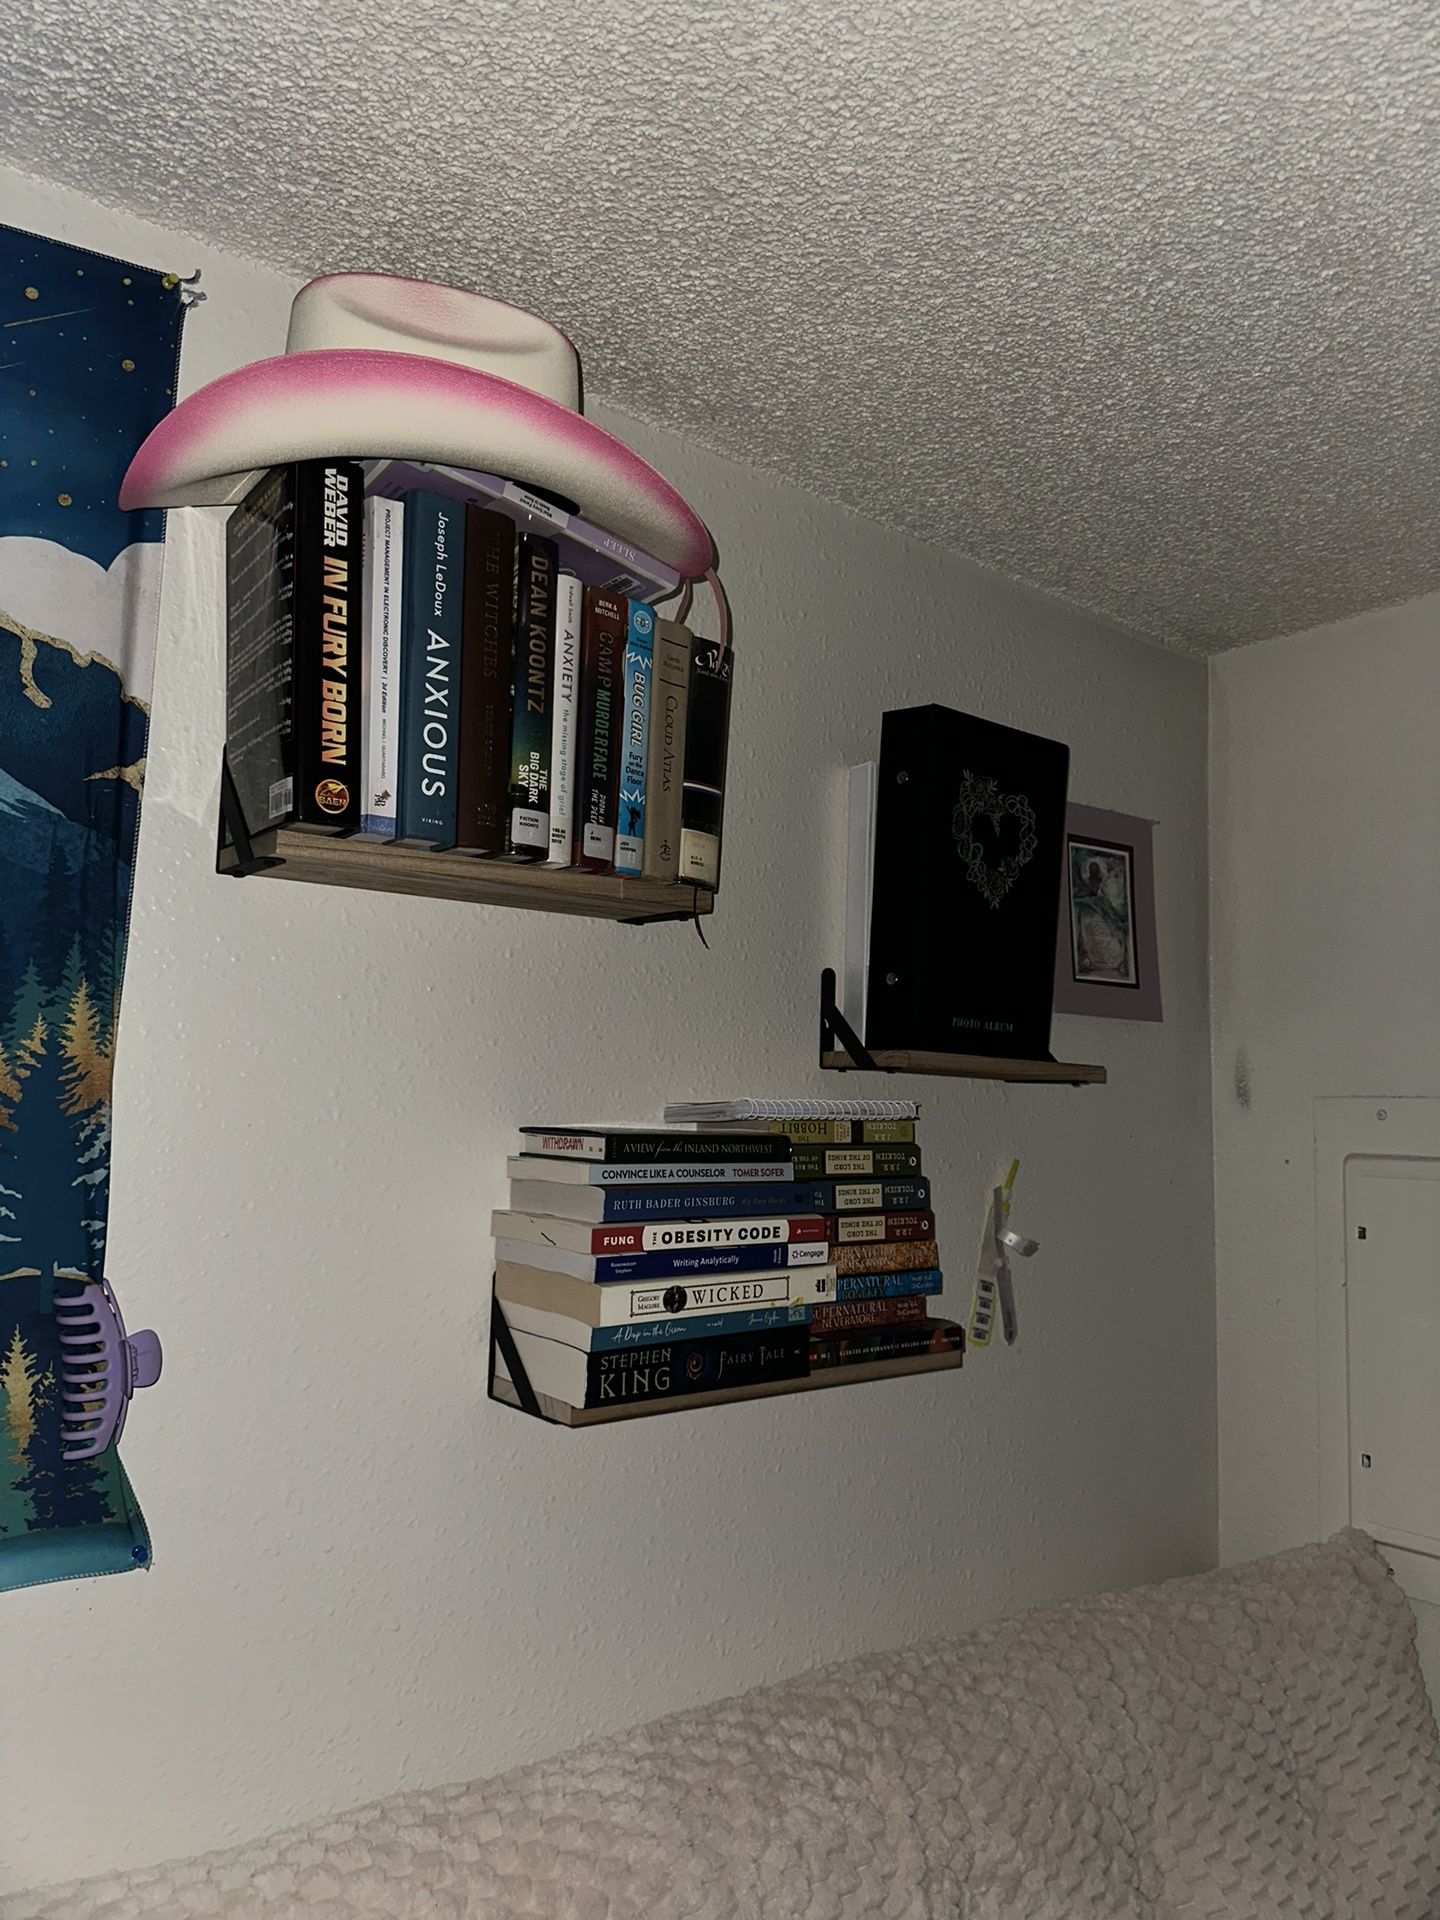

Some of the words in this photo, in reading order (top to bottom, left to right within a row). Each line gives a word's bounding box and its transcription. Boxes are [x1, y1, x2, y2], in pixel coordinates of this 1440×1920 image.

[323, 468, 337, 547] WEBER
[335, 475, 349, 547] DAVID
[435, 512, 449, 561] Joseph
[603, 538, 637, 561] SLEEP
[323, 555, 348, 591] IN
[433, 564, 447, 617] LeDoux
[530, 555, 548, 617] DEAN
[594, 606, 621, 621] MITCHELL
[599, 599, 613, 609] BERK
[322, 595, 348, 677] FURY
[482, 582, 500, 680] WITCHES
[526, 620, 547, 714] KOONTZ
[560, 629, 574, 703] ANXIETY
[598, 631, 616, 688] CAMP
[632, 671, 646, 708] BUG
[380, 691, 388, 713] Edition
[321, 679, 347, 765] BORN
[421, 629, 450, 797] ANXIOUS
[562, 709, 570, 722] the
[664, 695, 678, 746] CLOUD
[592, 689, 612, 781] MURDERFACE
[630, 710, 644, 747] GIRL
[560, 725, 569, 756] missing
[529, 751, 540, 771] BIG
[629, 751, 643, 763] Fury
[518, 764, 529, 788] SKY
[559, 758, 568, 782] stage
[625, 766, 644, 777] Dance
[662, 748, 676, 792] ATLAS
[528, 772, 539, 804] DARK
[539, 769, 548, 791] THE
[560, 784, 568, 793] of
[626, 776, 643, 787] Floor
[319, 797, 347, 806] BAEN
[557, 795, 567, 816] grief
[599, 794, 607, 814] DOOM
[421, 817, 444, 826] VIKING
[952, 1016, 981, 1029] PHOTO
[983, 1020, 1016, 1033] ALBUM
[780, 1123, 827, 1135] HOBBIT
[866, 1122, 897, 1130] TOLKIEN
[541, 1136, 585, 1152] WITHDRAWN
[623, 1143, 630, 1153] A
[630, 1142, 656, 1153] VIEW
[684, 1142, 719, 1153] INLAND
[719, 1143, 774, 1154] NORTHWEST
[875, 1153, 906, 1161] TOLKIEN
[601, 1168, 648, 1180] CONVINCE
[649, 1168, 667, 1179] LIKE
[667, 1168, 675, 1178] A
[676, 1167, 726, 1178] COUNSELOR
[732, 1167, 759, 1178] TOMER
[760, 1167, 785, 1177] SOFER
[834, 1163, 851, 1171] LORD
[852, 1163, 865, 1171] THE
[871, 1187, 880, 1195] OF
[884, 1185, 915, 1195] TOLKIEN
[613, 1199, 643, 1211] RUTH
[645, 1198, 681, 1210] BADER
[683, 1196, 736, 1208] GINSBURG
[862, 1197, 875, 1205] THE
[888, 1216, 918, 1226] TOLKIEN
[603, 1235, 635, 1247] FUNG
[661, 1228, 733, 1245] OBESITY
[737, 1226, 781, 1240] CODE
[846, 1230, 864, 1238] LORD
[864, 1229, 878, 1237] THE
[673, 1257, 699, 1269] Writing
[700, 1255, 740, 1266] Analytically
[798, 1249, 825, 1259] Cengage
[838, 1275, 903, 1290] PERNATURAL
[637, 1295, 660, 1303] GREGORY
[692, 1284, 764, 1305] WICKED
[812, 1301, 889, 1320] UPERNATURAL
[822, 1314, 876, 1329] NEVERMORE
[611, 1329, 623, 1343] A
[623, 1326, 641, 1342] Drop
[651, 1325, 662, 1336] the
[600, 1348, 671, 1371] STEPHEN
[717, 1350, 753, 1380] FAIRY
[758, 1345, 785, 1366] TALE
[599, 1366, 670, 1400] KING
